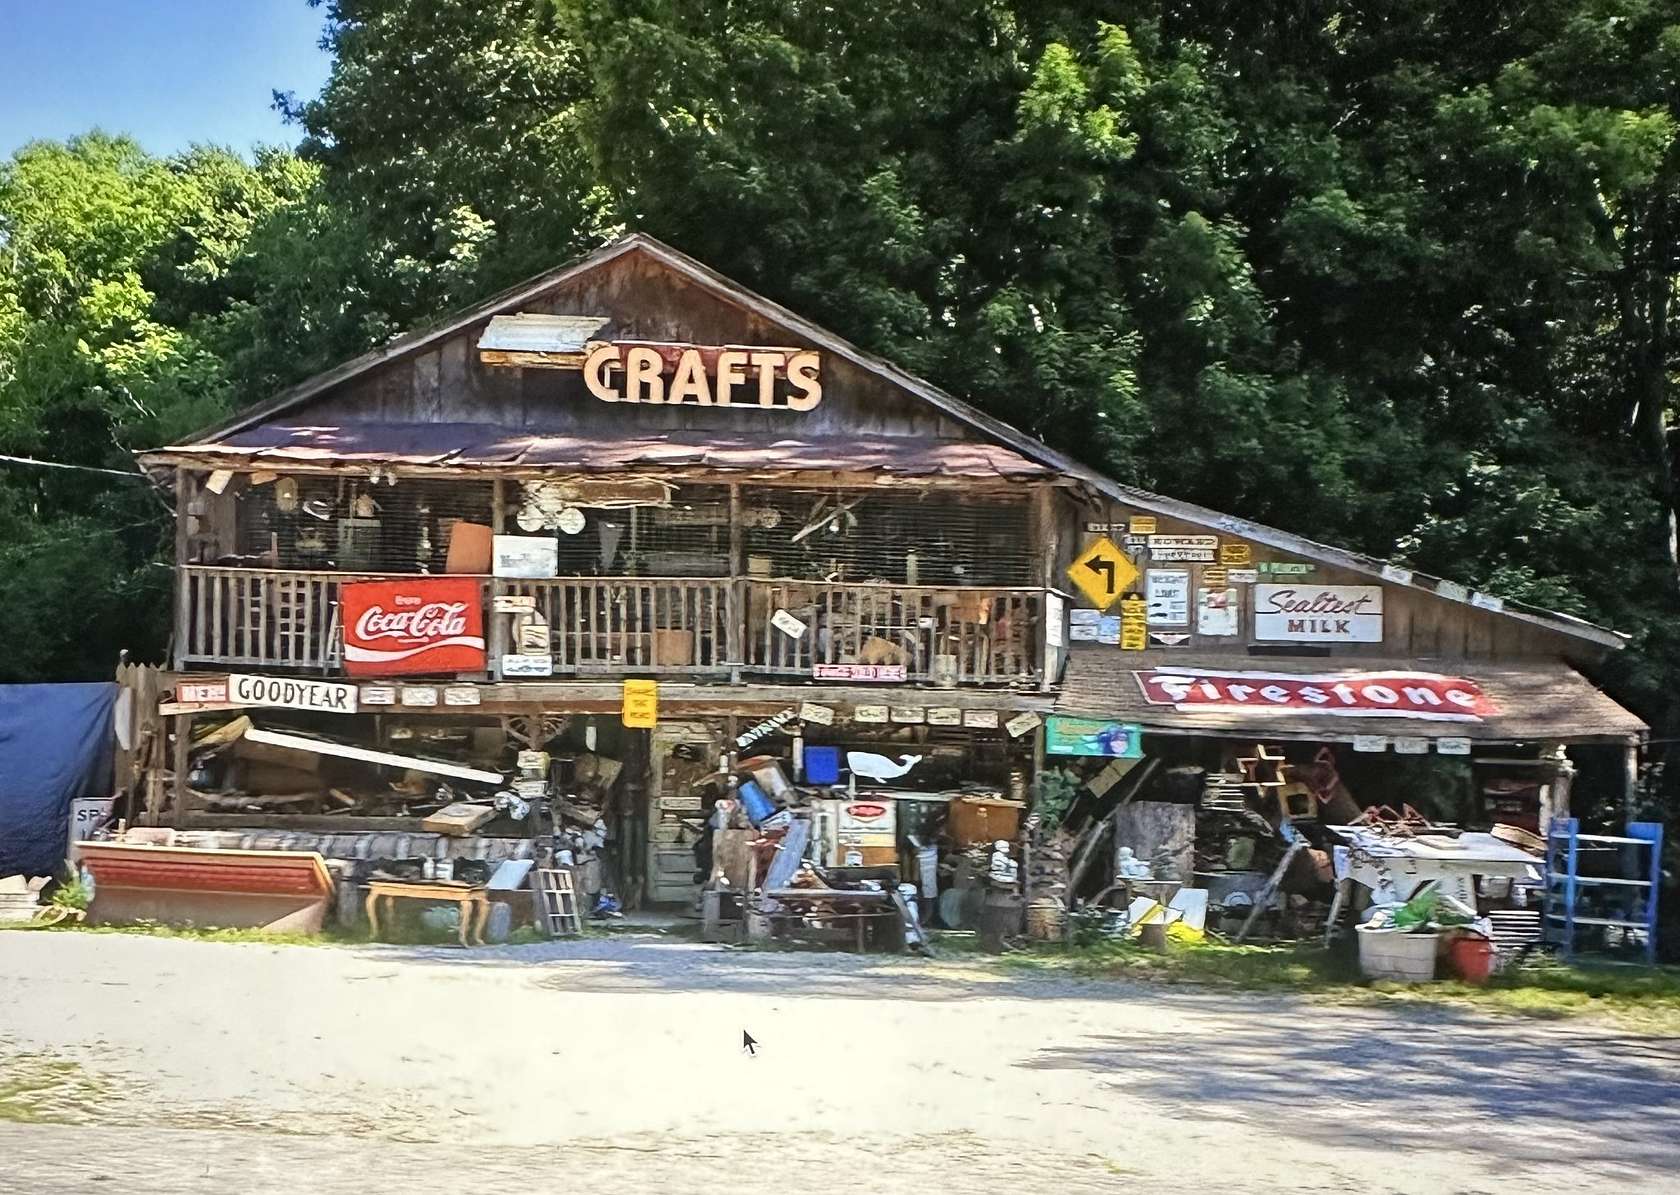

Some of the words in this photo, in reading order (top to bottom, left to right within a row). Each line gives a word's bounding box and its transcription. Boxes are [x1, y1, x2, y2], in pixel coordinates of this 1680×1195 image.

[584, 345, 822, 411] CRAFTS
[1268, 589, 1373, 614] Sealtest
[355, 602, 469, 641] Coca-Cola
[1287, 619, 1351, 634] MILK
[238, 678, 347, 710] GOODYEAR
[1149, 675, 1475, 707] Firestone
